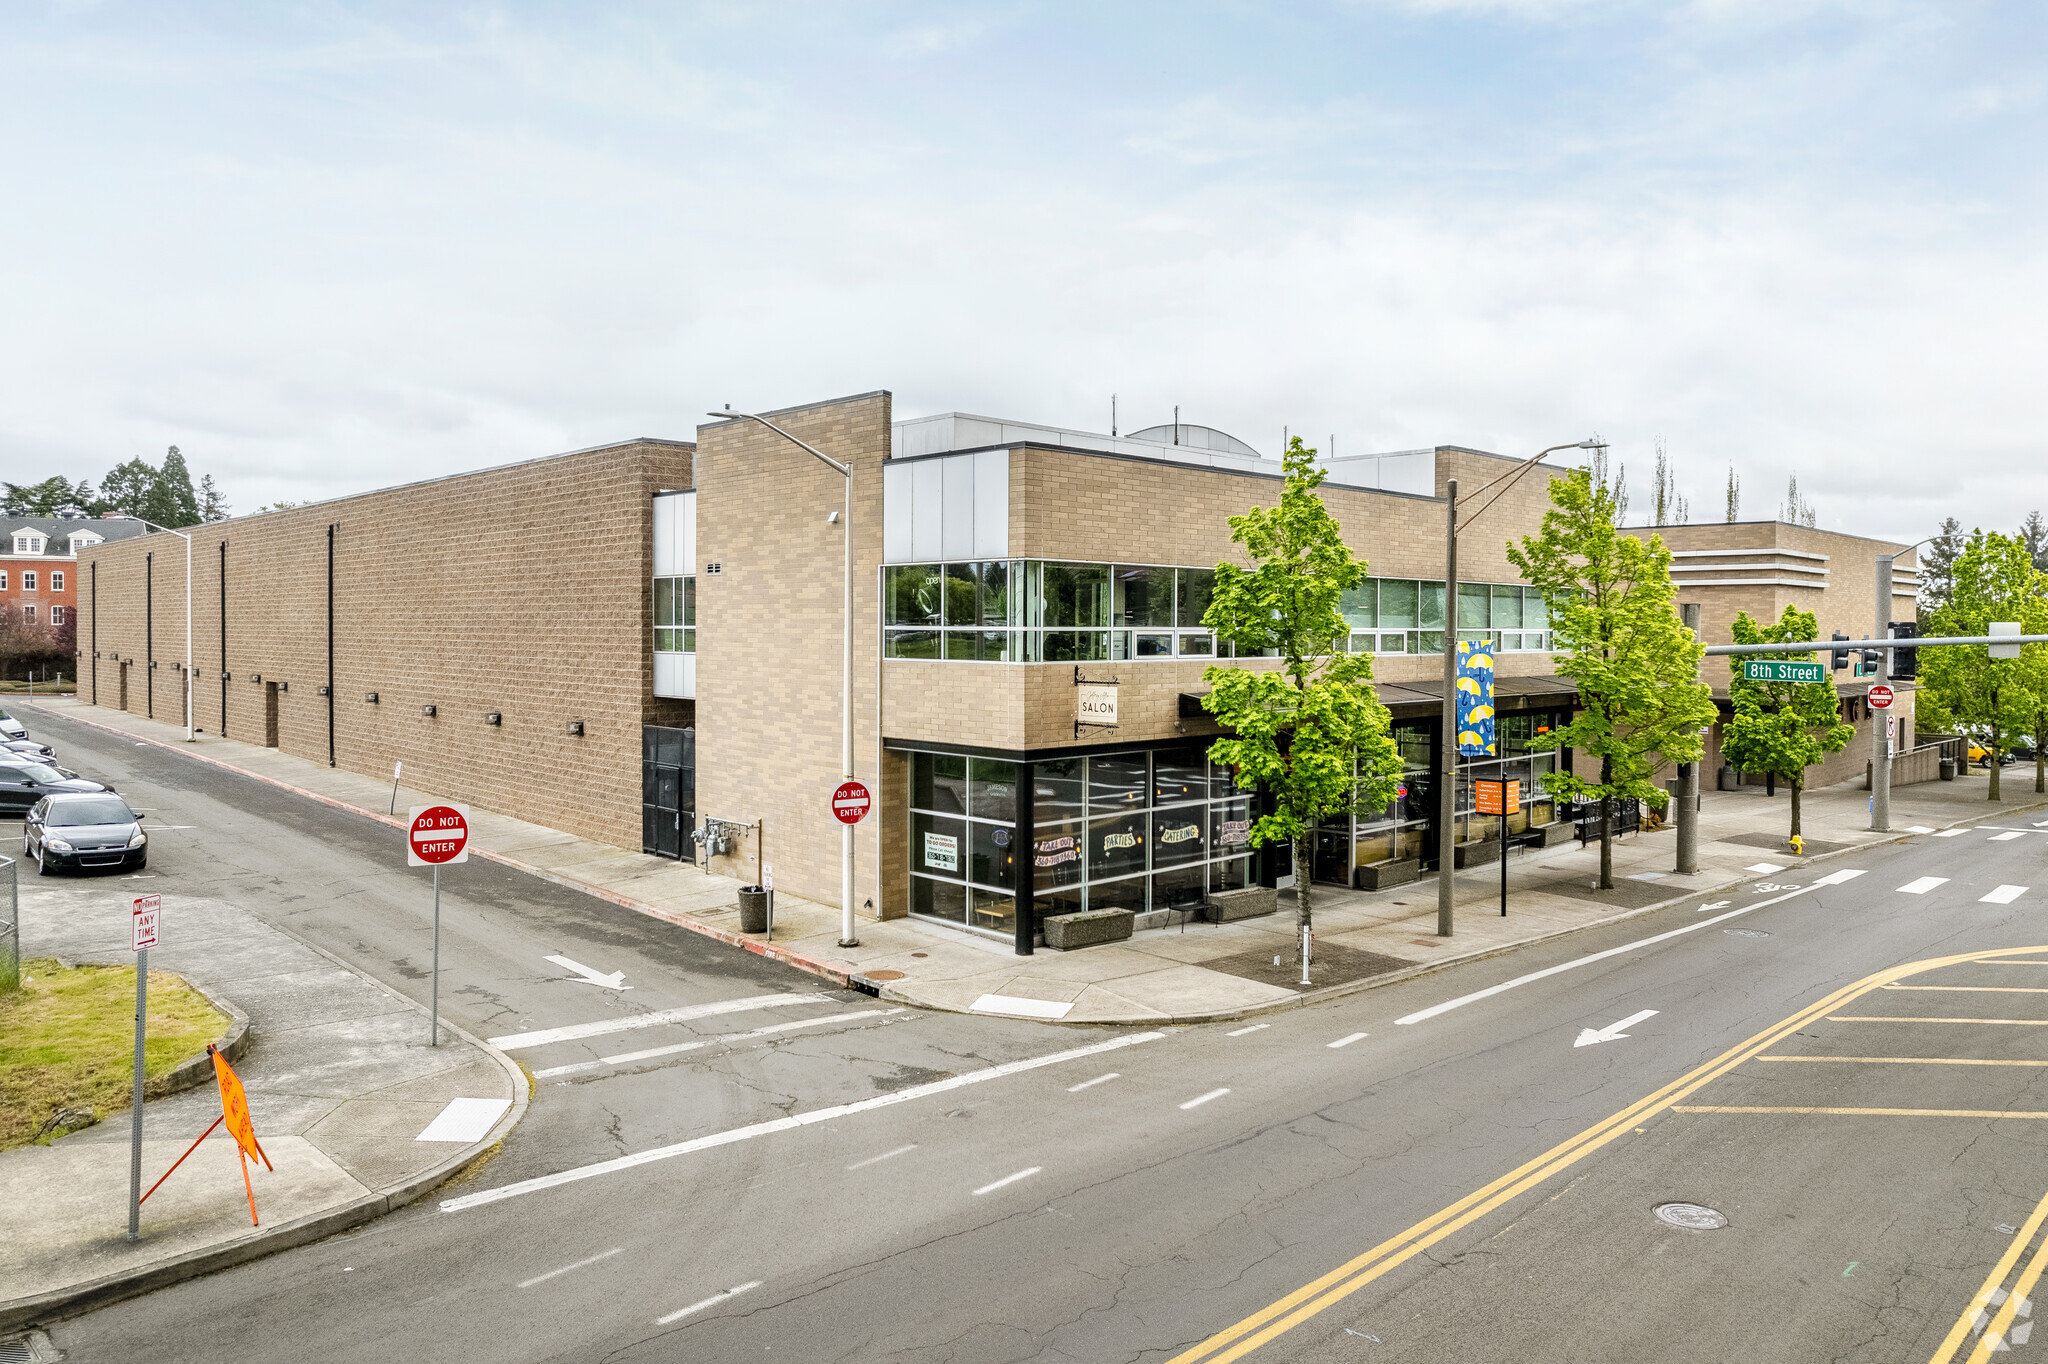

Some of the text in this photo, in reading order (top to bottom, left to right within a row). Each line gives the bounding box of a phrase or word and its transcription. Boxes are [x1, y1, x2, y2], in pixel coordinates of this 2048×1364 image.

[1750, 664, 1818, 680] 8th Street
[1082, 702, 1114, 713] SALON
[837, 789, 865, 798] DO NOT
[840, 808, 863, 817] ENTER
[419, 817, 460, 828] DO NOT
[1164, 827, 1195, 841] CATERING
[1042, 838, 1073, 850] TAKE OUT
[1106, 834, 1133, 848] PARTIES
[422, 842, 455, 853] ENTER
[134, 899, 160, 912] NO PARKING
[138, 914, 154, 927] ANY
[137, 926, 155, 939] TIME
[765, 950, 776, 959] FIRE
[222, 1071, 232, 1096] ROAD
